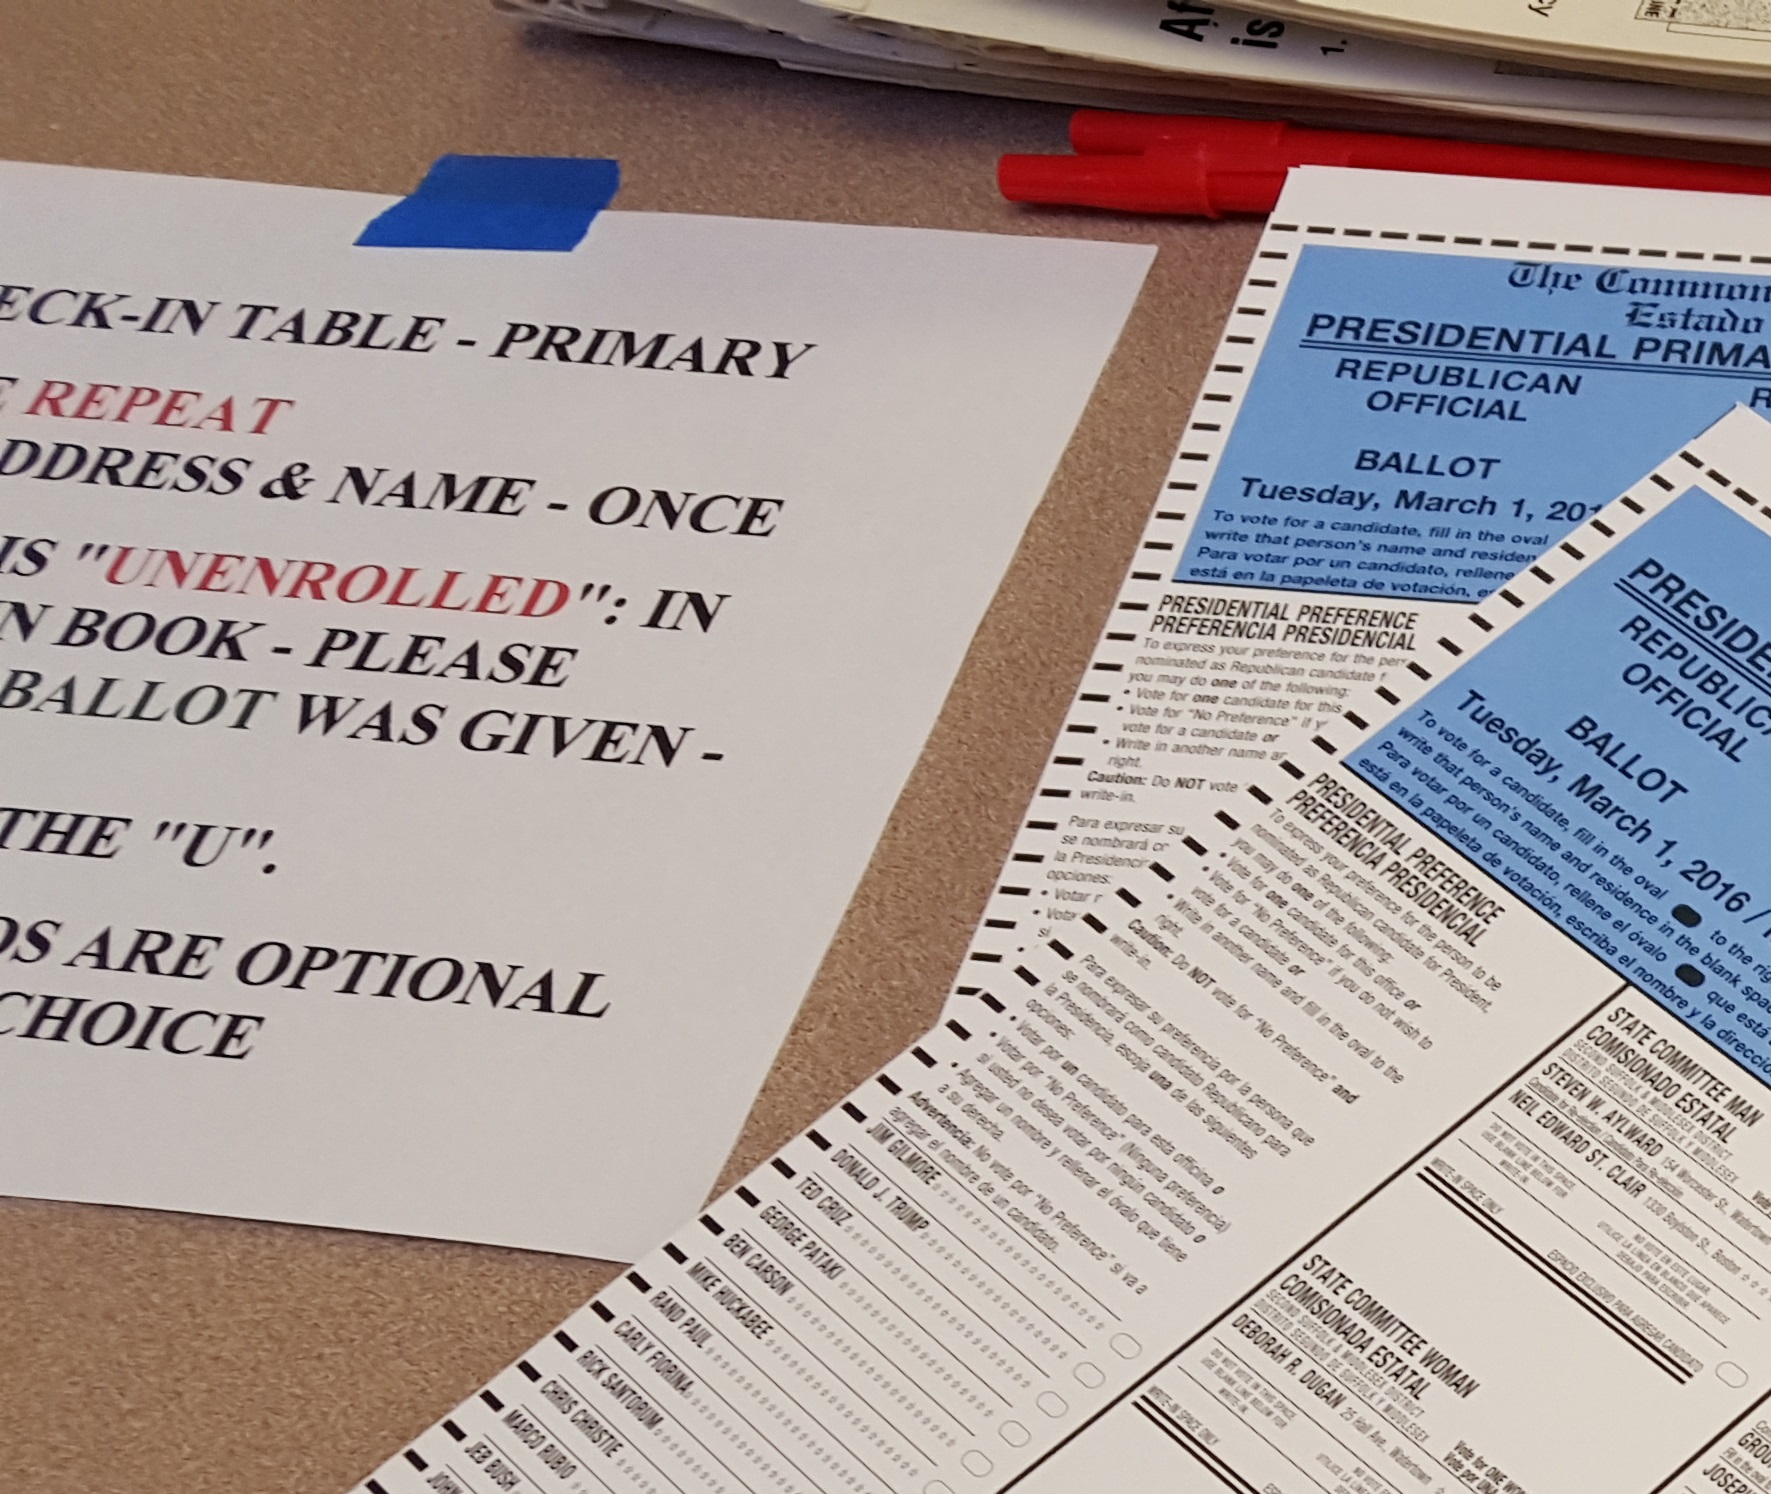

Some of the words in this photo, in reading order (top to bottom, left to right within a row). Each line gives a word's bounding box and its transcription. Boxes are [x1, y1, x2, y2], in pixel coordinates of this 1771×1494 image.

[1229, 18, 1287, 50] is
[1507, 260, 1583, 296] The
[229, 303, 447, 353] TABLE
[489, 322, 817, 380] PRIMARY
[1306, 313, 1617, 359] PRESIDENTIAL
[1625, 301, 1765, 334] Estado
[1334, 357, 1583, 396] REPUBLICAN
[23, 379, 296, 435] REPEAT
[1366, 390, 1527, 422] OFFICIAL
[1354, 448, 1501, 480] BALLOT
[259, 462, 316, 501] &
[325, 465, 537, 517] NAME
[588, 486, 785, 538] ONCE
[1241, 476, 1380, 512] Tuesday,
[1394, 489, 1497, 516] March
[1512, 498, 1534, 523] 1,
[638, 589, 732, 633] IN
[1150, 614, 1277, 641] PREFERENCIA
[1281, 623, 1416, 651] PRESIDENCIAL
[1157, 594, 1289, 622] PRESIDENTIAL
[1296, 604, 1419, 630] PREFERENCE
[51, 606, 267, 662] BOOK
[303, 627, 579, 688] PLEASE
[297, 693, 447, 746] WAS
[459, 709, 696, 768] GIVEN
[1622, 662, 1748, 763] OFFICIAL
[1564, 714, 1689, 803] BALLOT
[61, 926, 225, 980] ARE
[236, 941, 610, 1019] OPTIONAL
[796, 1176, 824, 1201] TED
[816, 1195, 854, 1227] CRUZ
[831, 1148, 877, 1193] DONALD
[872, 1187, 891, 1199] J.
[886, 1195, 930, 1232] TRUMP
[502, 1410, 547, 1450] MARCO
[537, 1443, 577, 1480] RUBIO
